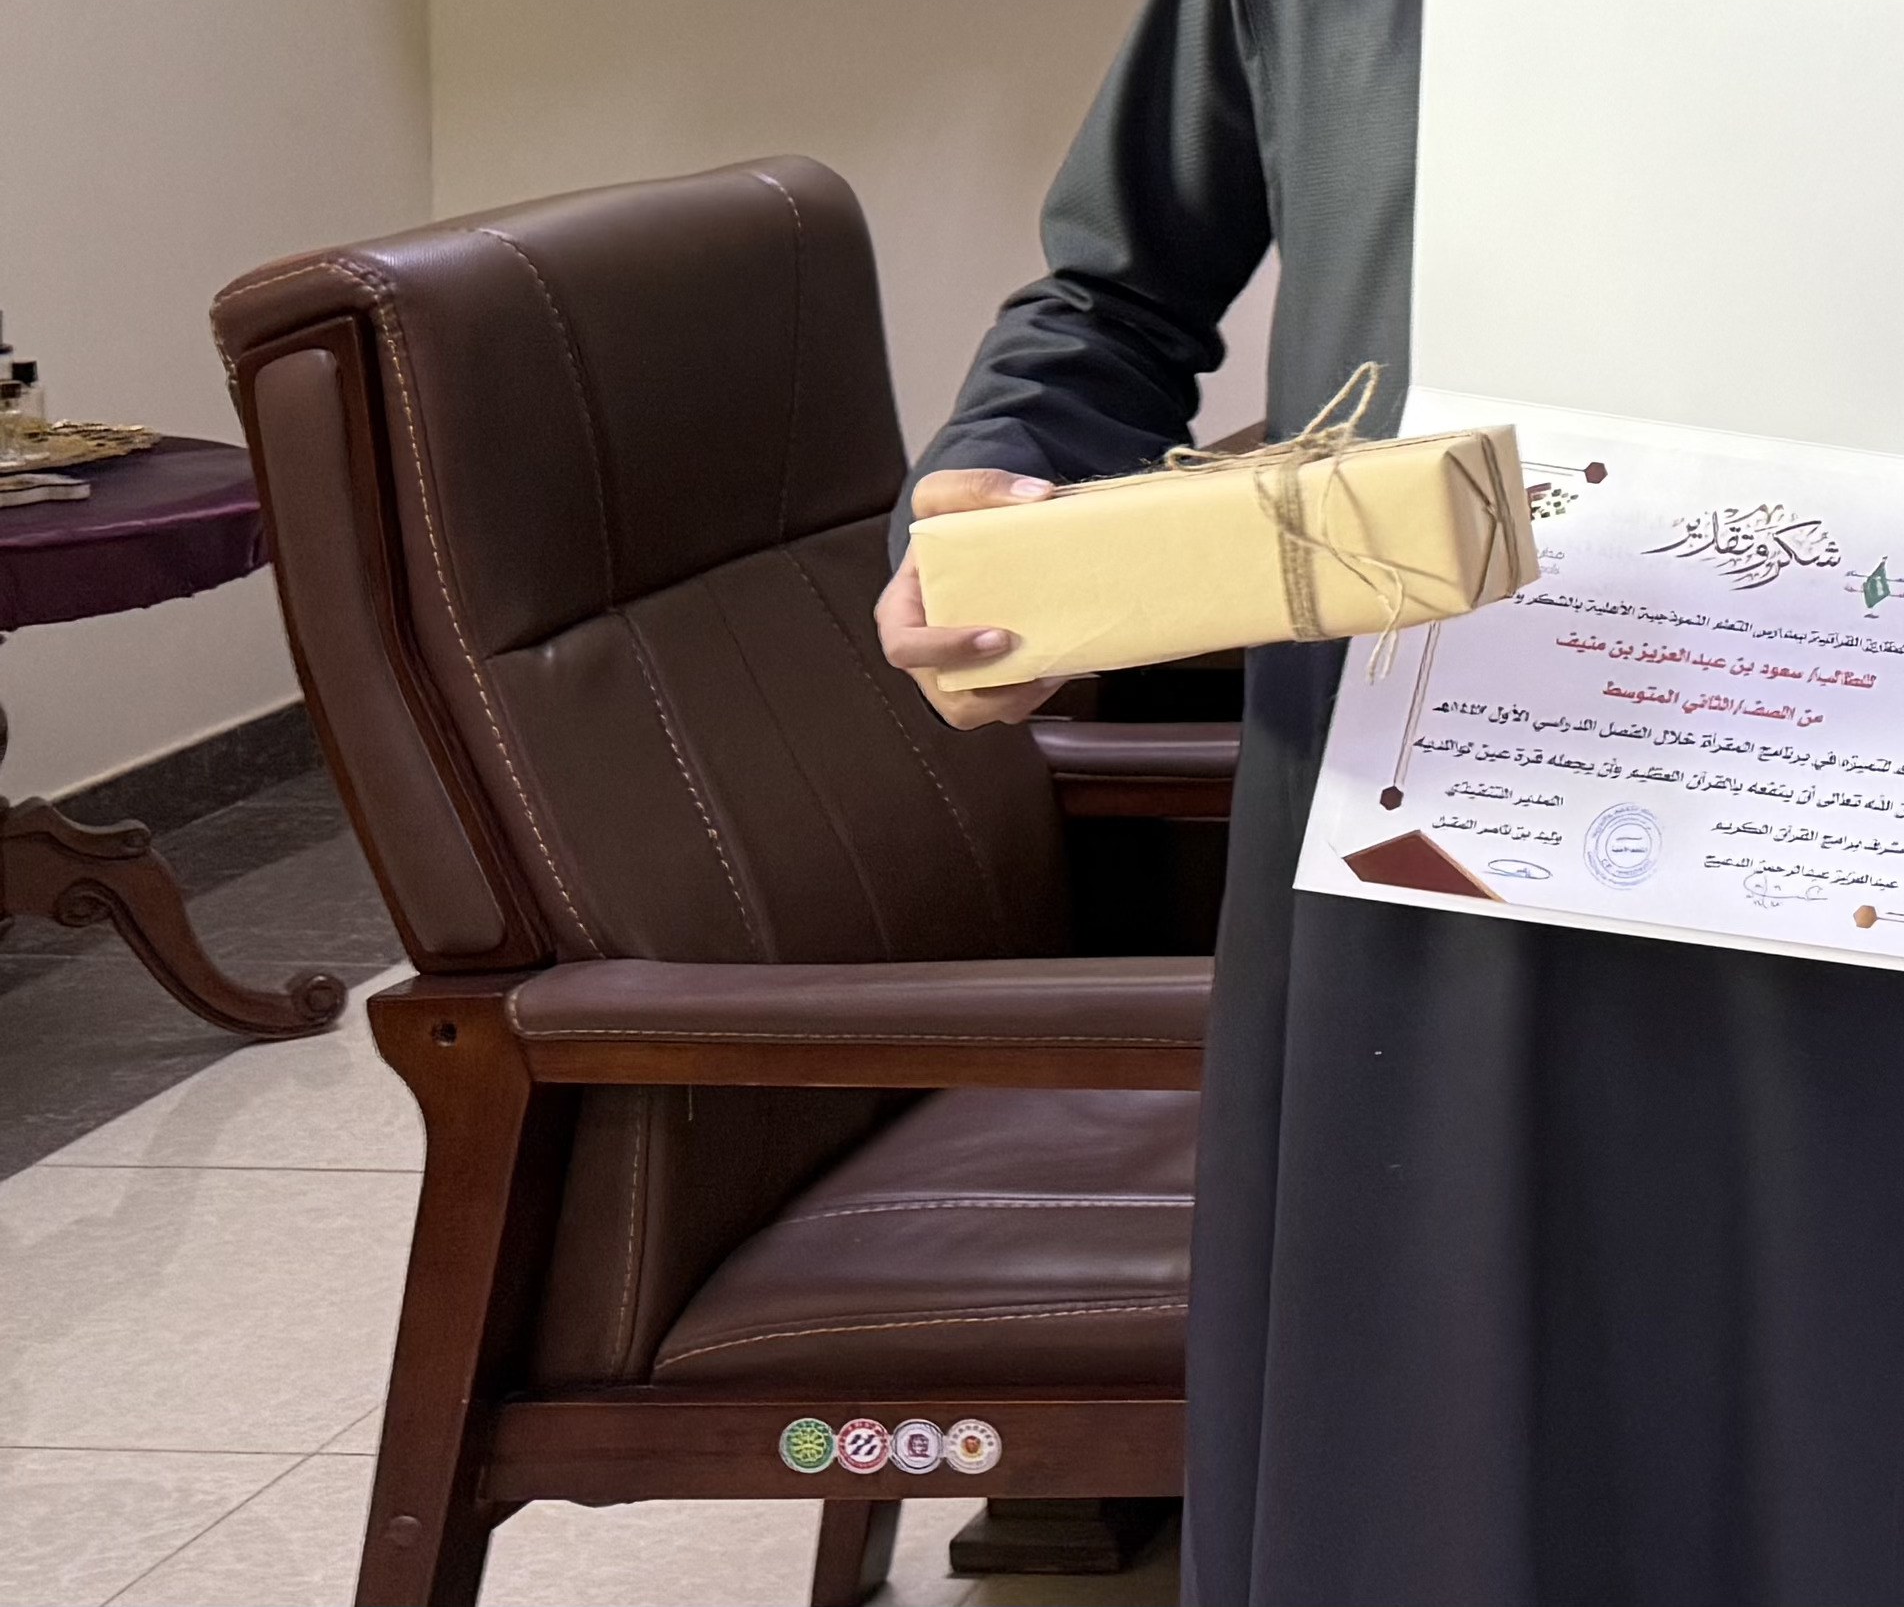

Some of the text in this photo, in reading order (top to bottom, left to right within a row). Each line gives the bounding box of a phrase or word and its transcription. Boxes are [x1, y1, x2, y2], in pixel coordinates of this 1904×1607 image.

[1555, 631, 1608, 654] منيف
[1609, 640, 1634, 659] بن
[1729, 658, 1755, 676] بن
[1758, 660, 1803, 680] سعود
[1601, 680, 1680, 705] المتوسط
[1488, 703, 1530, 725] الأول
[1796, 710, 1825, 727] من
[1653, 731, 1696, 747] خلال
[1474, 744, 1511, 762] عين
[1513, 748, 1544, 767] قرة
[1757, 744, 1811, 765] برنامج
[1810, 750, 1837, 770] في
[1597, 757, 1623, 779] وأن
[1795, 785, 1817, 805] أن
